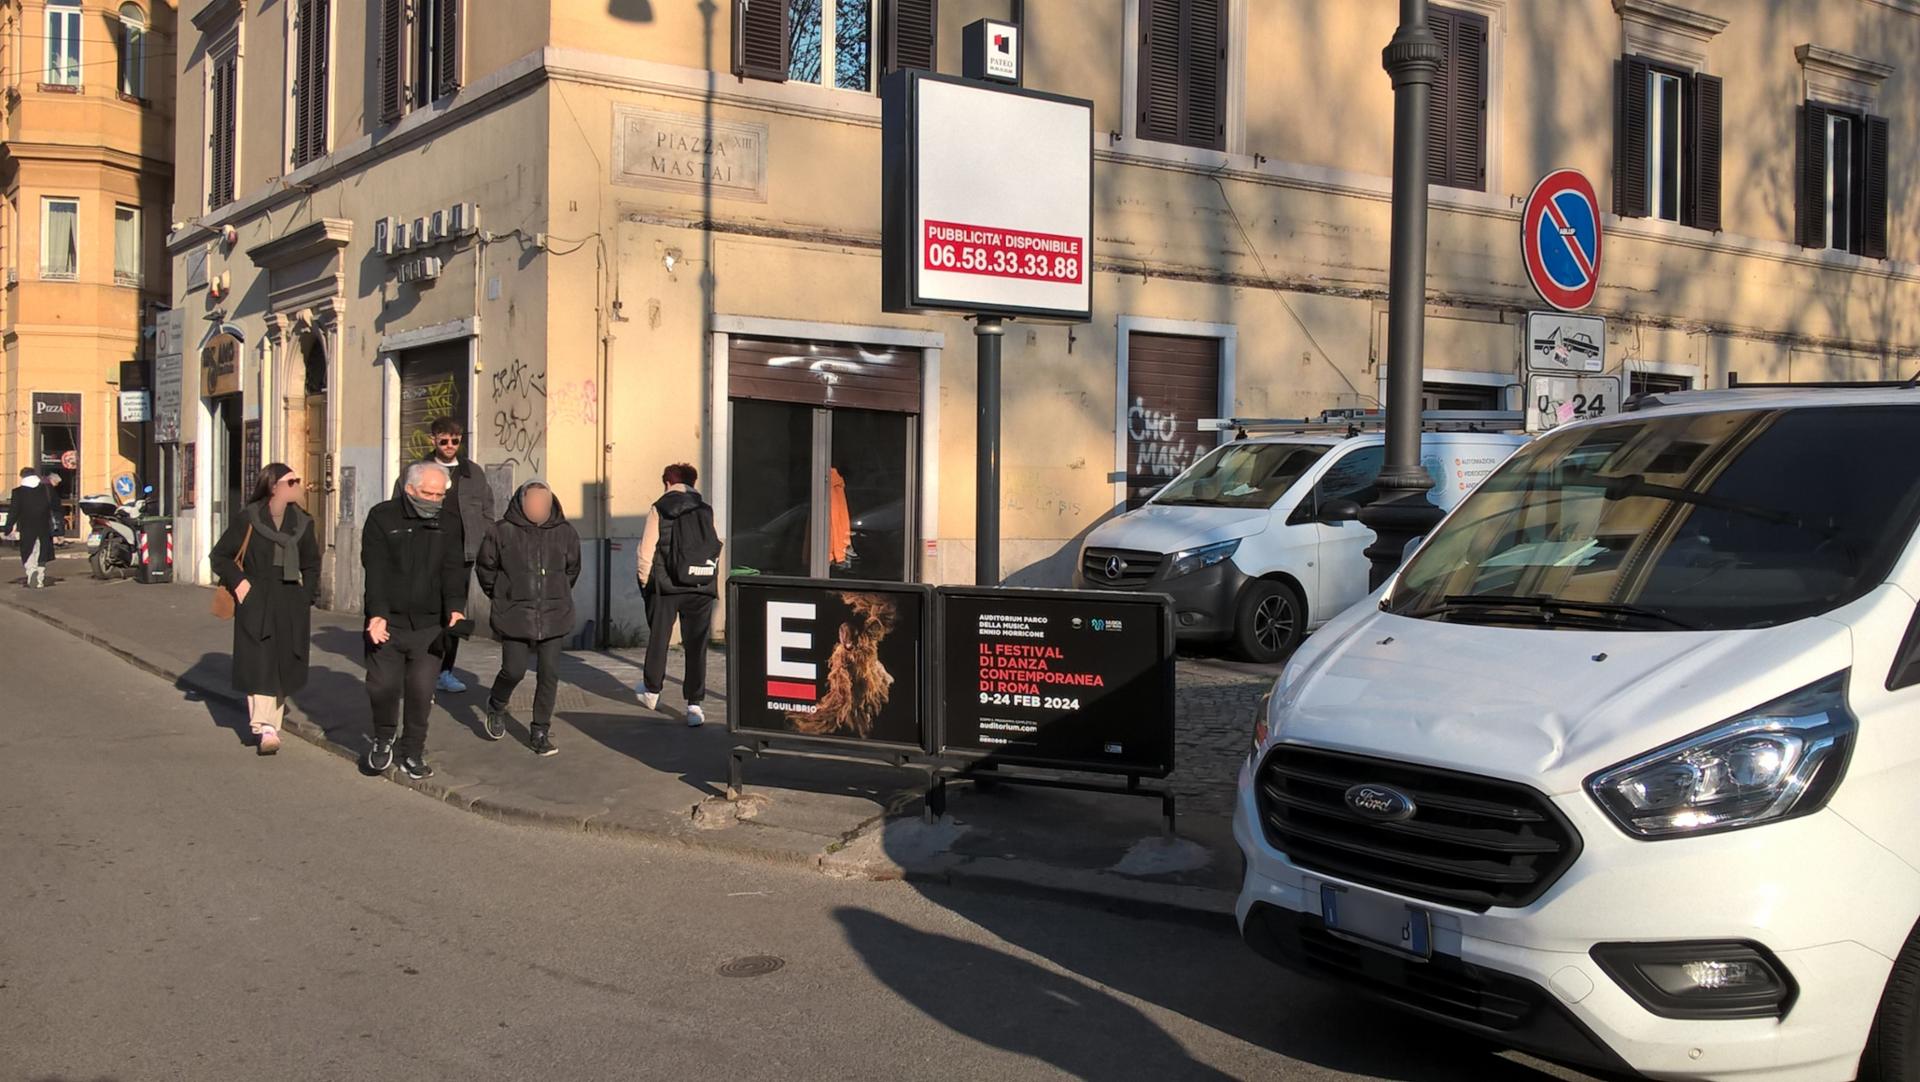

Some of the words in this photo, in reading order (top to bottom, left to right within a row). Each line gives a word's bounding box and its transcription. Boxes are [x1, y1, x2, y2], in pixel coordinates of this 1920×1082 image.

[990, 58, 1013, 67] PATEO
[657, 131, 726, 156] PIAZZA
[650, 156, 731, 182] MASTAI
[928, 225, 1003, 246] PUBBLICITA'
[1005, 234, 1078, 254] DISPONIBILE
[929, 243, 1079, 280] 06.58.33.33.88
[1573, 394, 1605, 414] 24
[688, 565, 714, 576] PUMA
[979, 614, 1022, 623] AUDITORIUM
[979, 621, 1001, 629] DELLA
[766, 601, 817, 680] E
[979, 628, 1001, 636] ENNIO
[1002, 630, 1045, 638] MORRICONE
[979, 643, 992, 654] IL
[995, 644, 1064, 659] FESTIVAL
[980, 656, 994, 667] DI
[997, 657, 1048, 670] DANZA
[980, 668, 1104, 687] CONTEMPORANEA
[980, 681, 994, 692] DI
[997, 682, 1040, 695] ROMA
[767, 701, 817, 714] EQUILIBRIO
[979, 692, 1011, 705] 9-24
[1013, 695, 1041, 708] FEB
[1043, 697, 1080, 710] 2024
[979, 722, 1038, 733] auditorium.com
[1355, 788, 1393, 812] Ford
